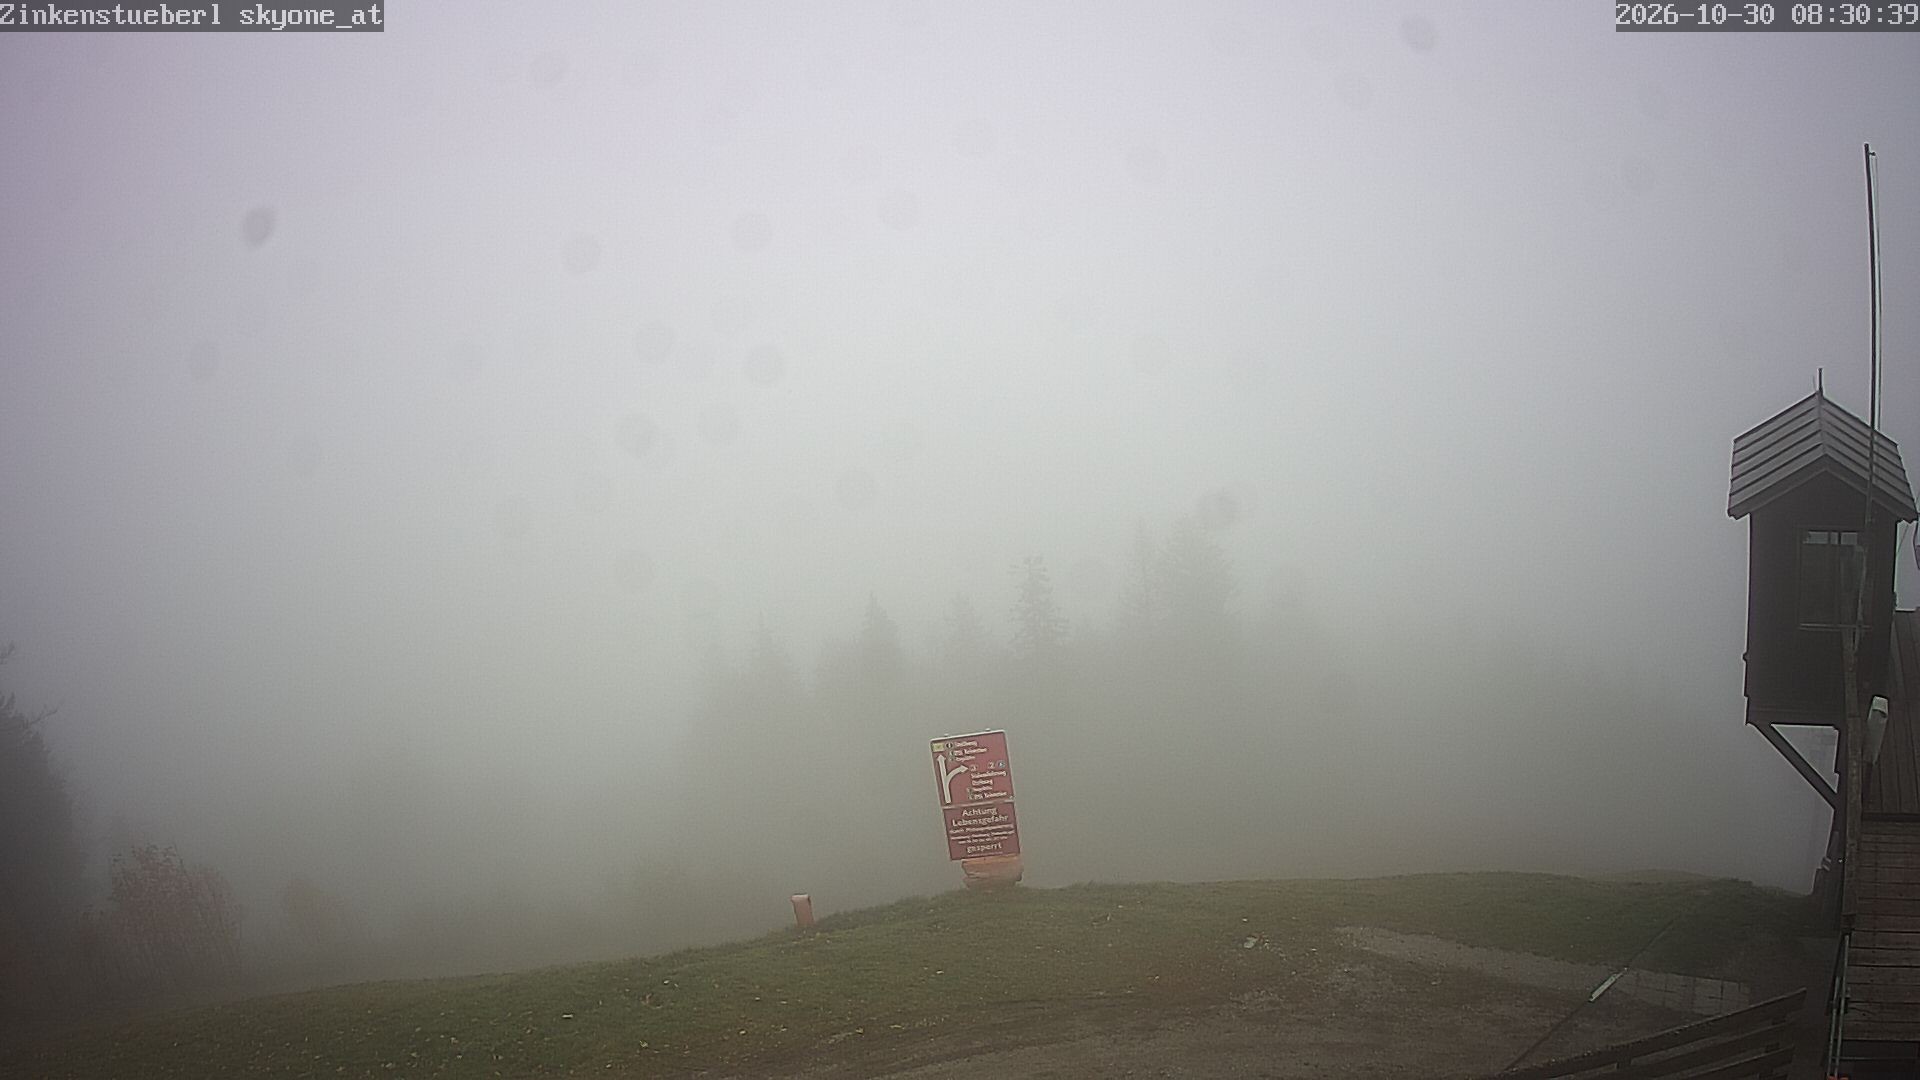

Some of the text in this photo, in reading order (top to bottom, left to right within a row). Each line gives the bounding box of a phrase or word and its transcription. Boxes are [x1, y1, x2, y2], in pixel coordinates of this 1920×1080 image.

[962, 807, 998, 817] Achtung
[952, 815, 1009, 827] Lebensgefahr
[966, 842, 1002, 853] gesperrt
